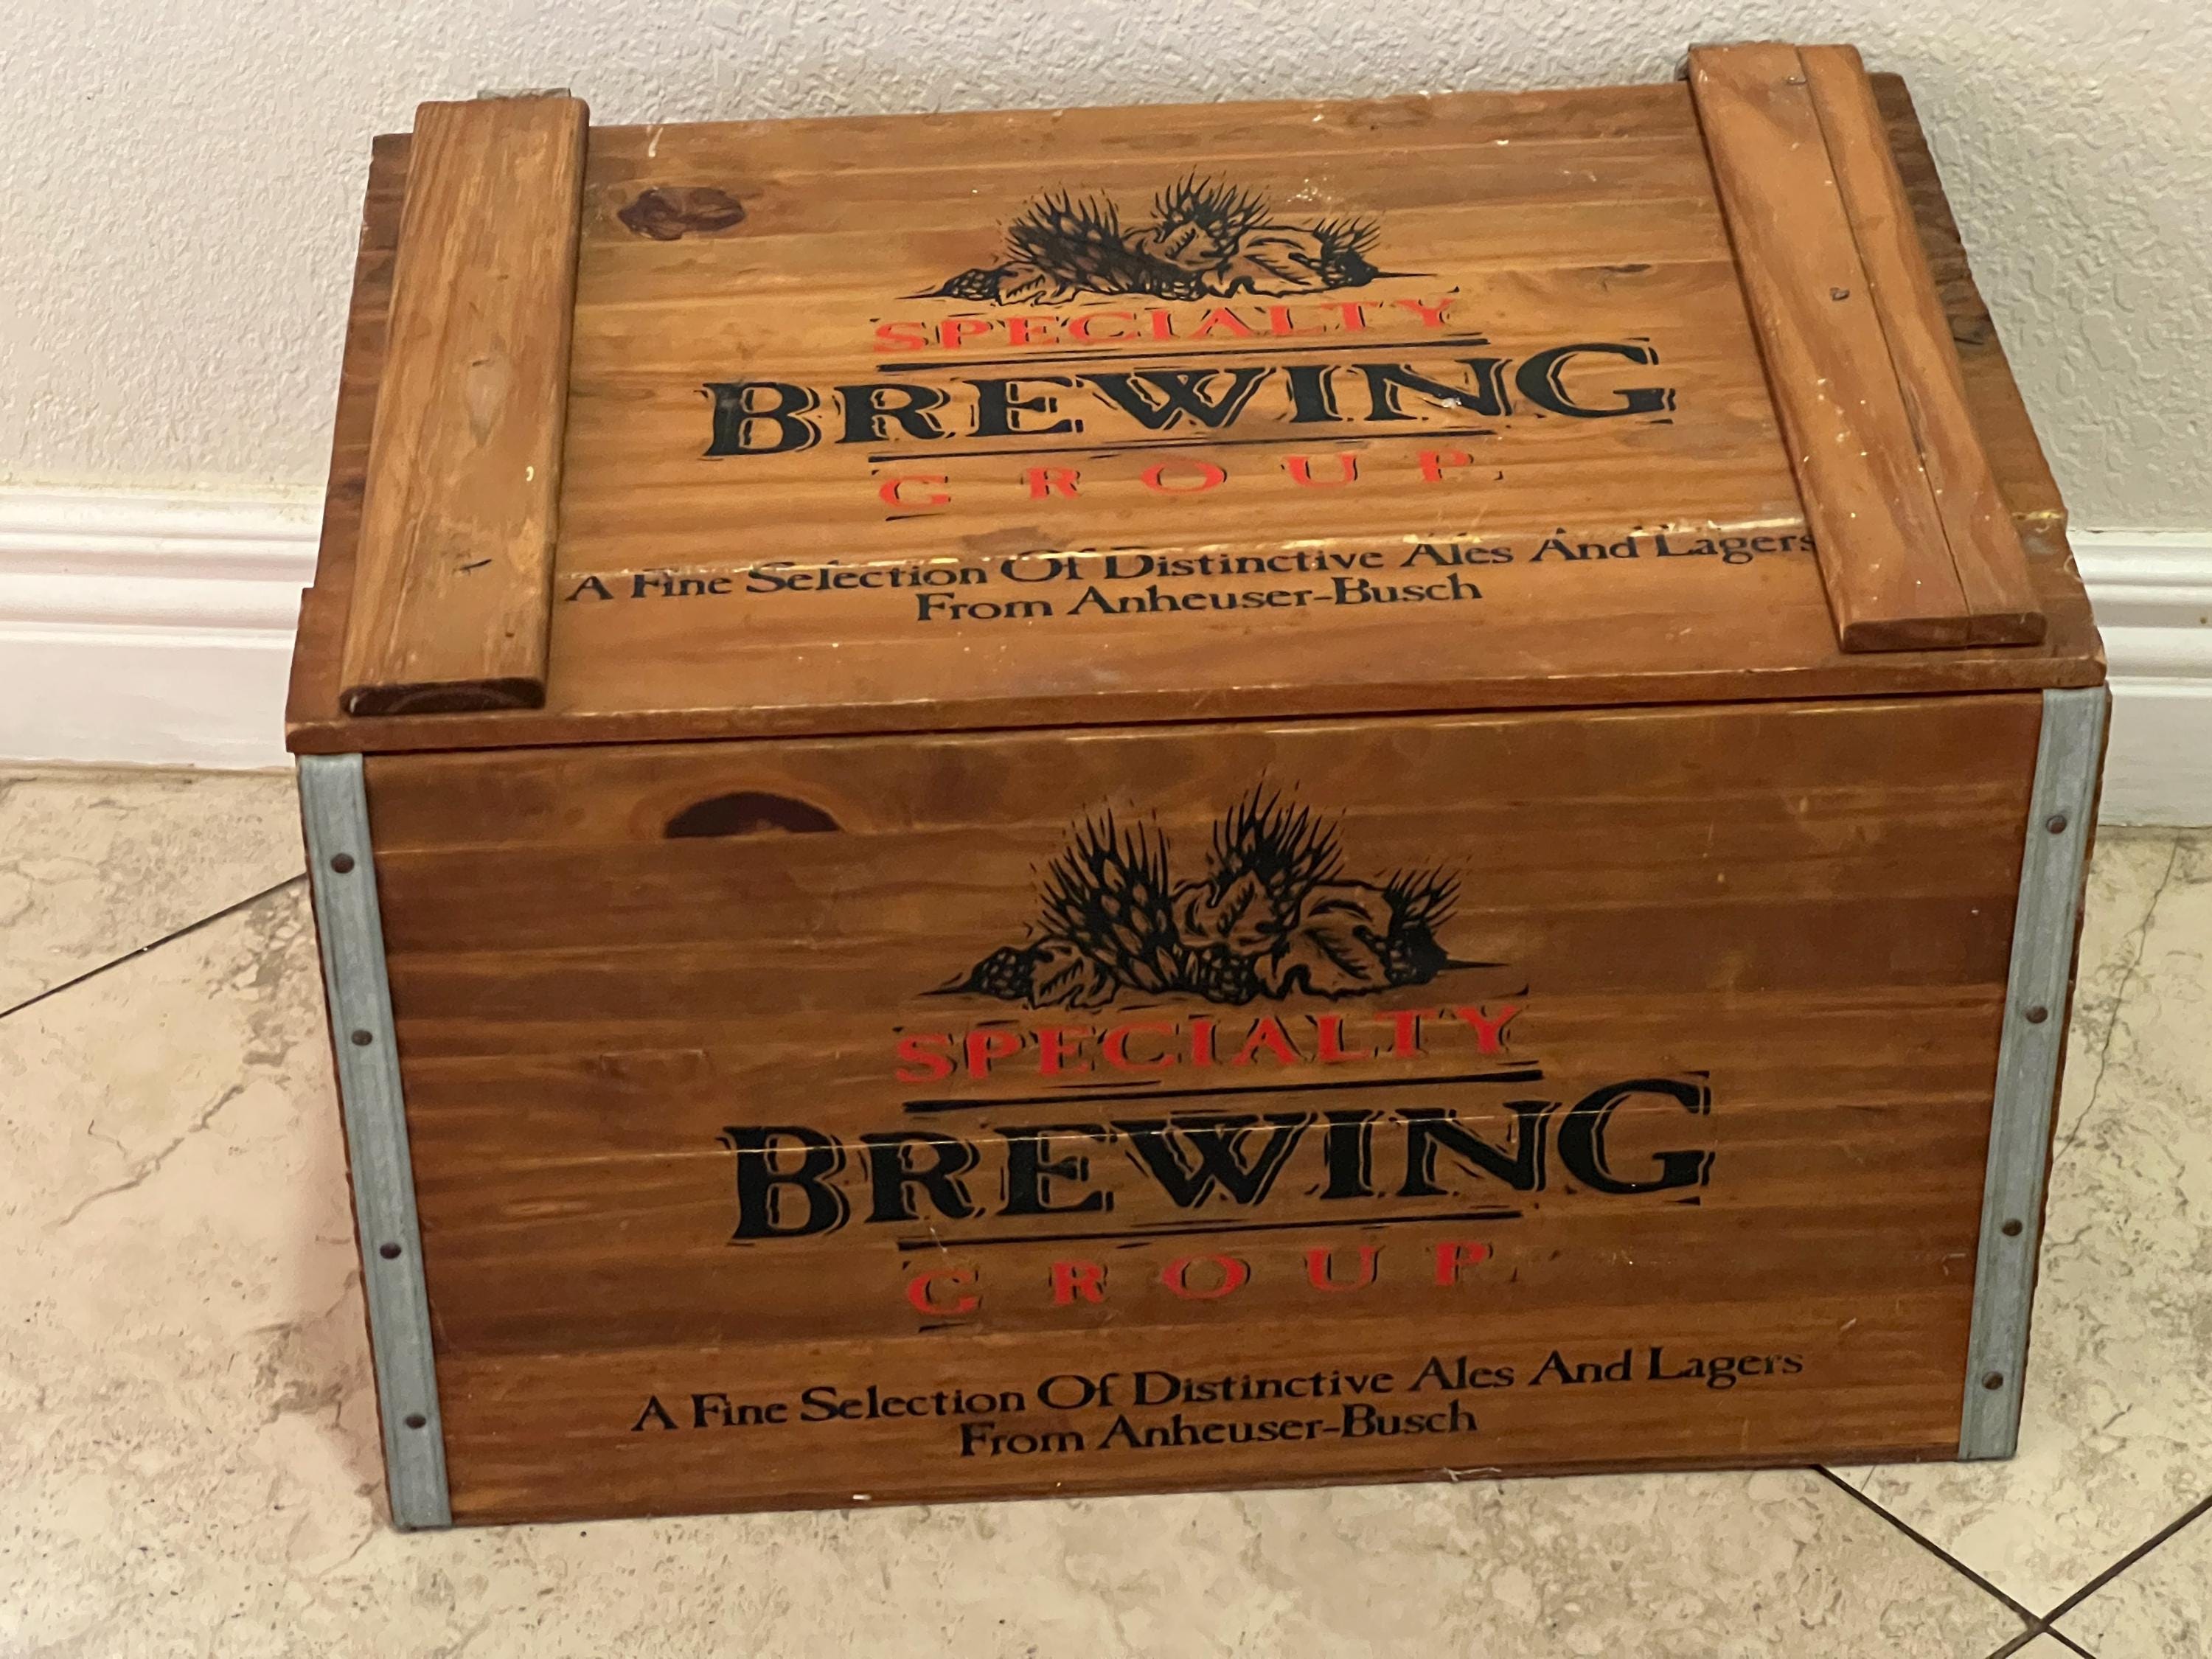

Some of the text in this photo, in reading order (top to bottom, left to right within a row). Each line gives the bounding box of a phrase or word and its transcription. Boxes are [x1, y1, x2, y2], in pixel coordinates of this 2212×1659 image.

[874, 298, 1455, 352] SPECIALTY
[699, 341, 1675, 457] BREWING
[878, 451, 1474, 507] GROUP
[565, 574, 613, 601] A
[630, 567, 733, 598] Fine
[746, 560, 987, 593] Selection
[1001, 547, 1096, 582] Of
[1105, 546, 1384, 580] Distinctive
[1400, 532, 1514, 567] Ales
[1528, 527, 1648, 562] And
[917, 572, 1483, 622] From Anheuser-Busch
[895, 1005, 1520, 1083] SPECIALTY
[721, 1077, 1715, 1240] BREWING
[907, 1241, 1494, 1315] GROUP
[631, 1346, 1804, 1431] A Fine Selection Of Distinctive Ales And Lagers
[961, 1399, 1478, 1457] From Anheuser-Busch
